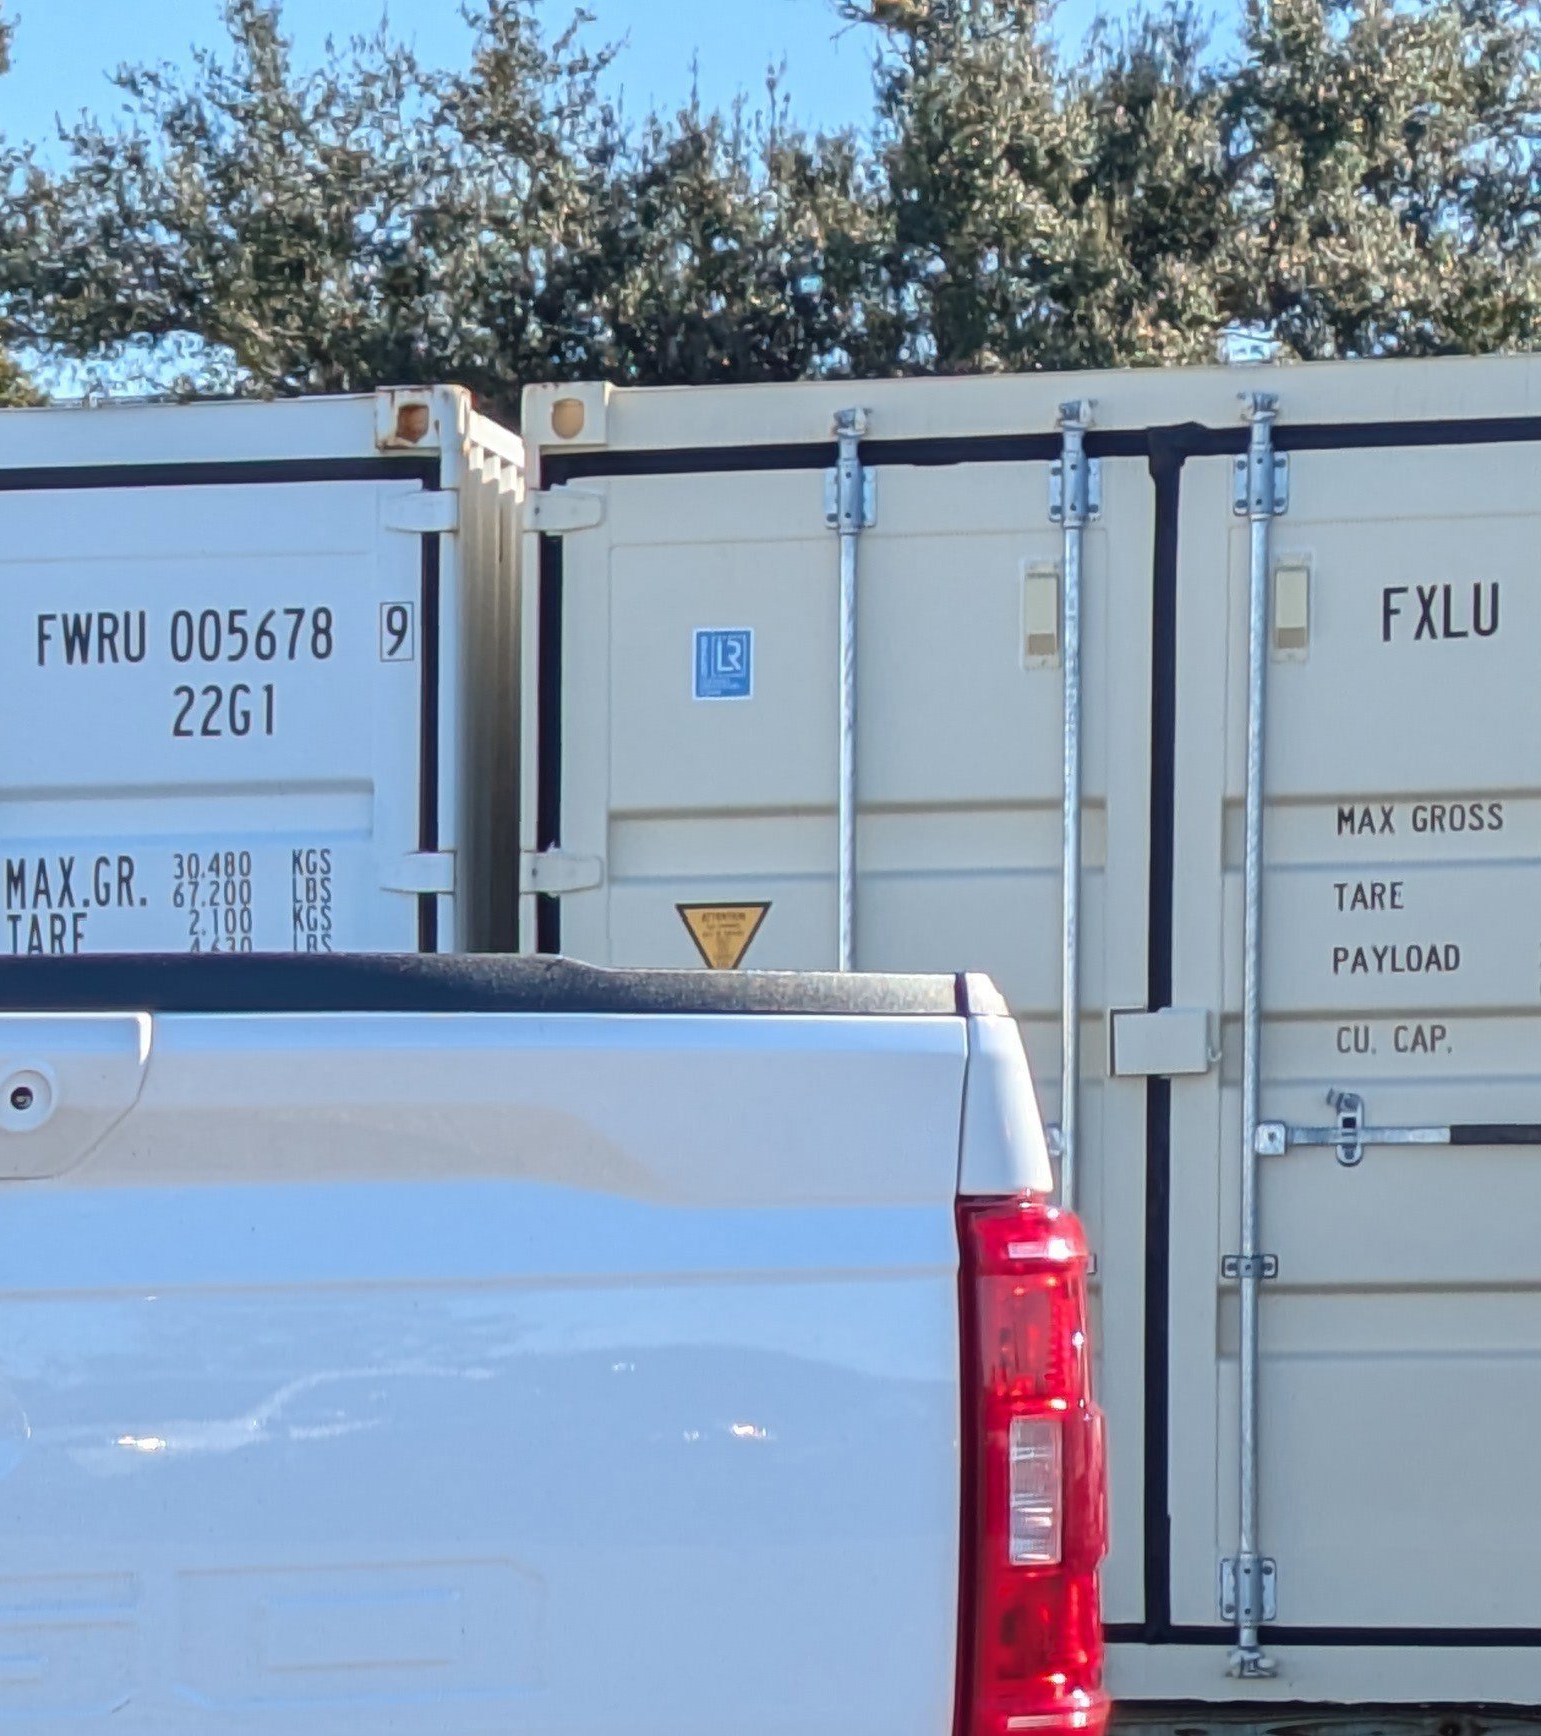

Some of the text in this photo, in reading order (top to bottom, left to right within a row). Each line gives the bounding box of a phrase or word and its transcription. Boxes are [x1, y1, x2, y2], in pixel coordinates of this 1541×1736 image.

[1382, 582, 1499, 642] FXLU
[37, 605, 409, 666] FWRU 005678 9
[172, 684, 274, 737] 22G1
[1337, 803, 1504, 835] MAX GROSS
[6, 848, 332, 909] MAX.GR. 30.480 KGS
[173, 877, 332, 908] 67.200 LBS
[1334, 881, 1404, 911] TARE
[188, 907, 253, 936] 2.100
[292, 903, 332, 932] KGS
[1333, 944, 1461, 975] PAYLOAD
[1336, 1025, 1377, 1054] CU.
